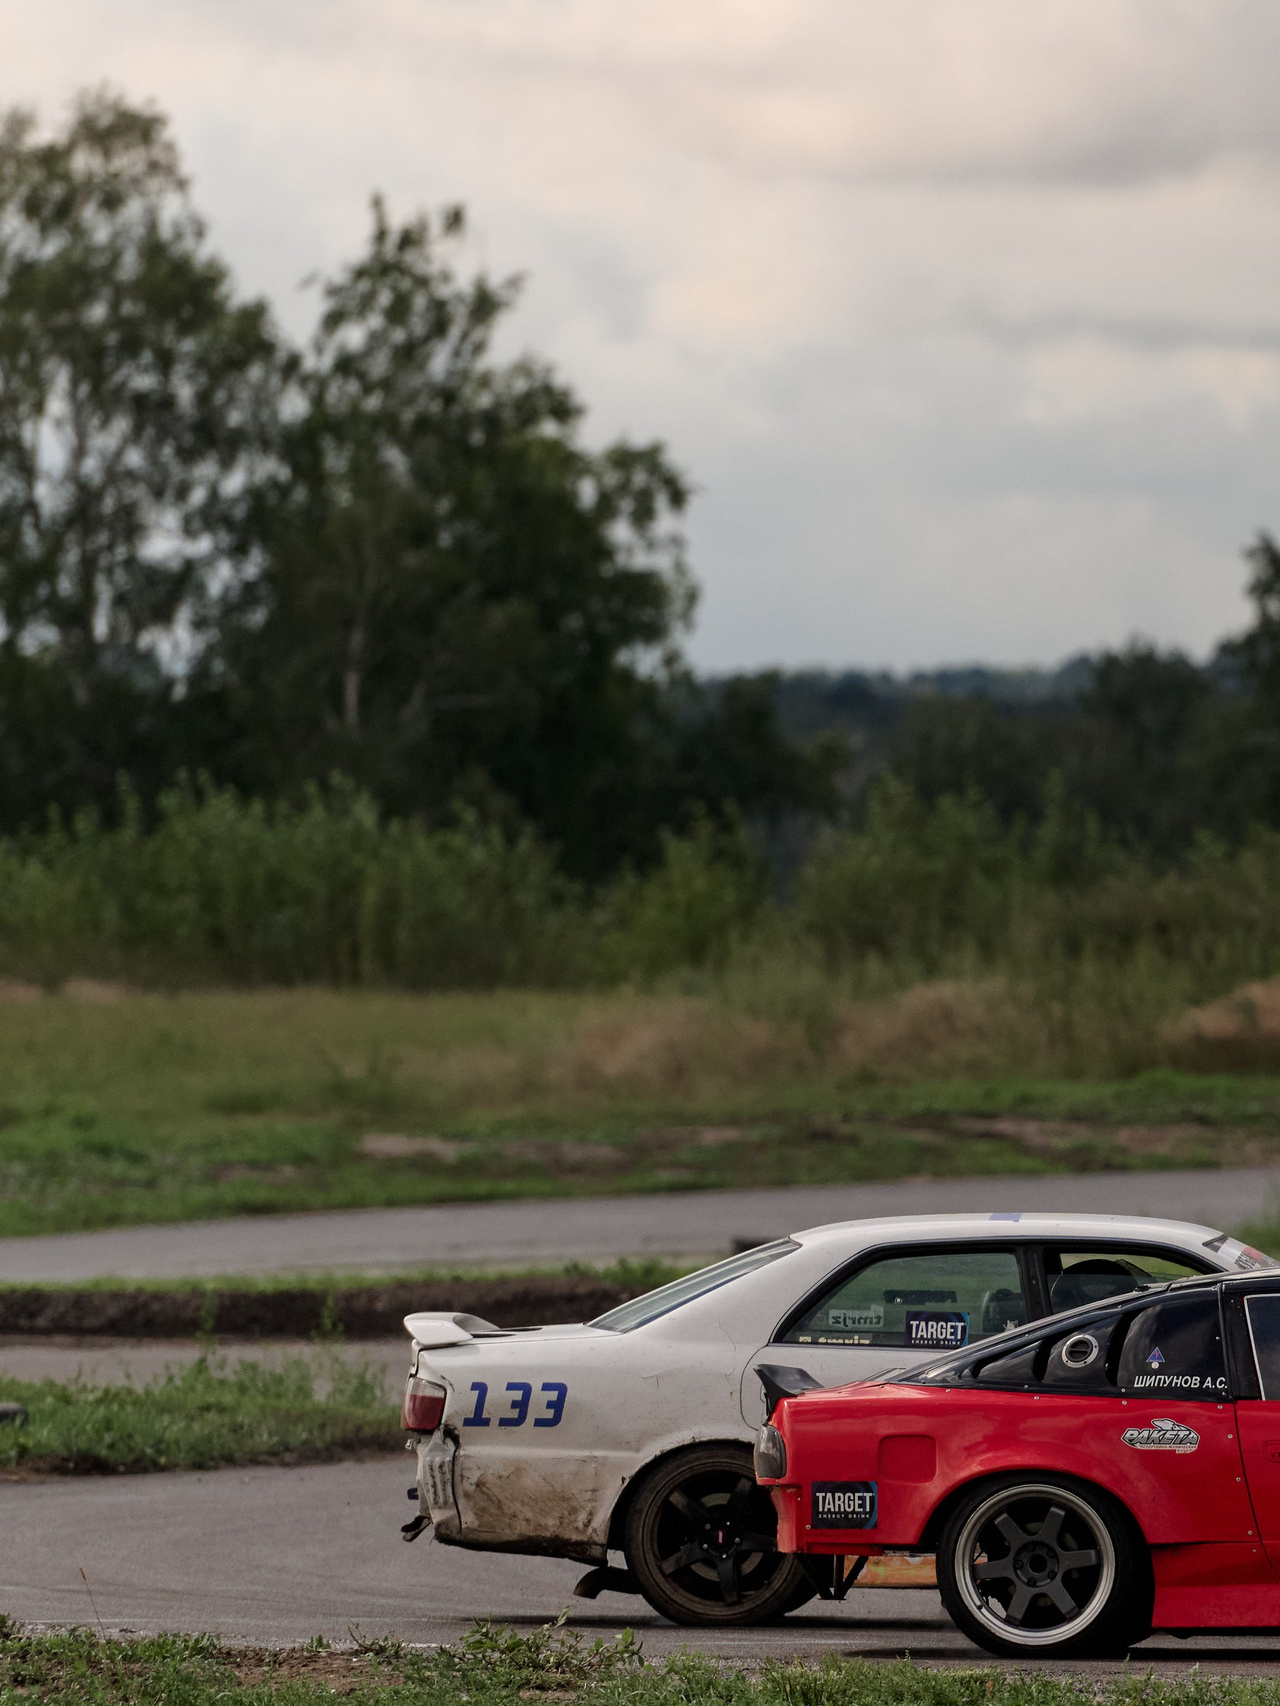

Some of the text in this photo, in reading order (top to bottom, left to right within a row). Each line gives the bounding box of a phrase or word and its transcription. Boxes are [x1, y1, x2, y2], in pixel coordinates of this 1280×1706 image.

[910, 1321, 965, 1340] TARGET
[1134, 1375, 1228, 1389] ШИПУНОВ А.С.
[462, 1382, 568, 1427] 133
[815, 1492, 873, 1512] TARGET
